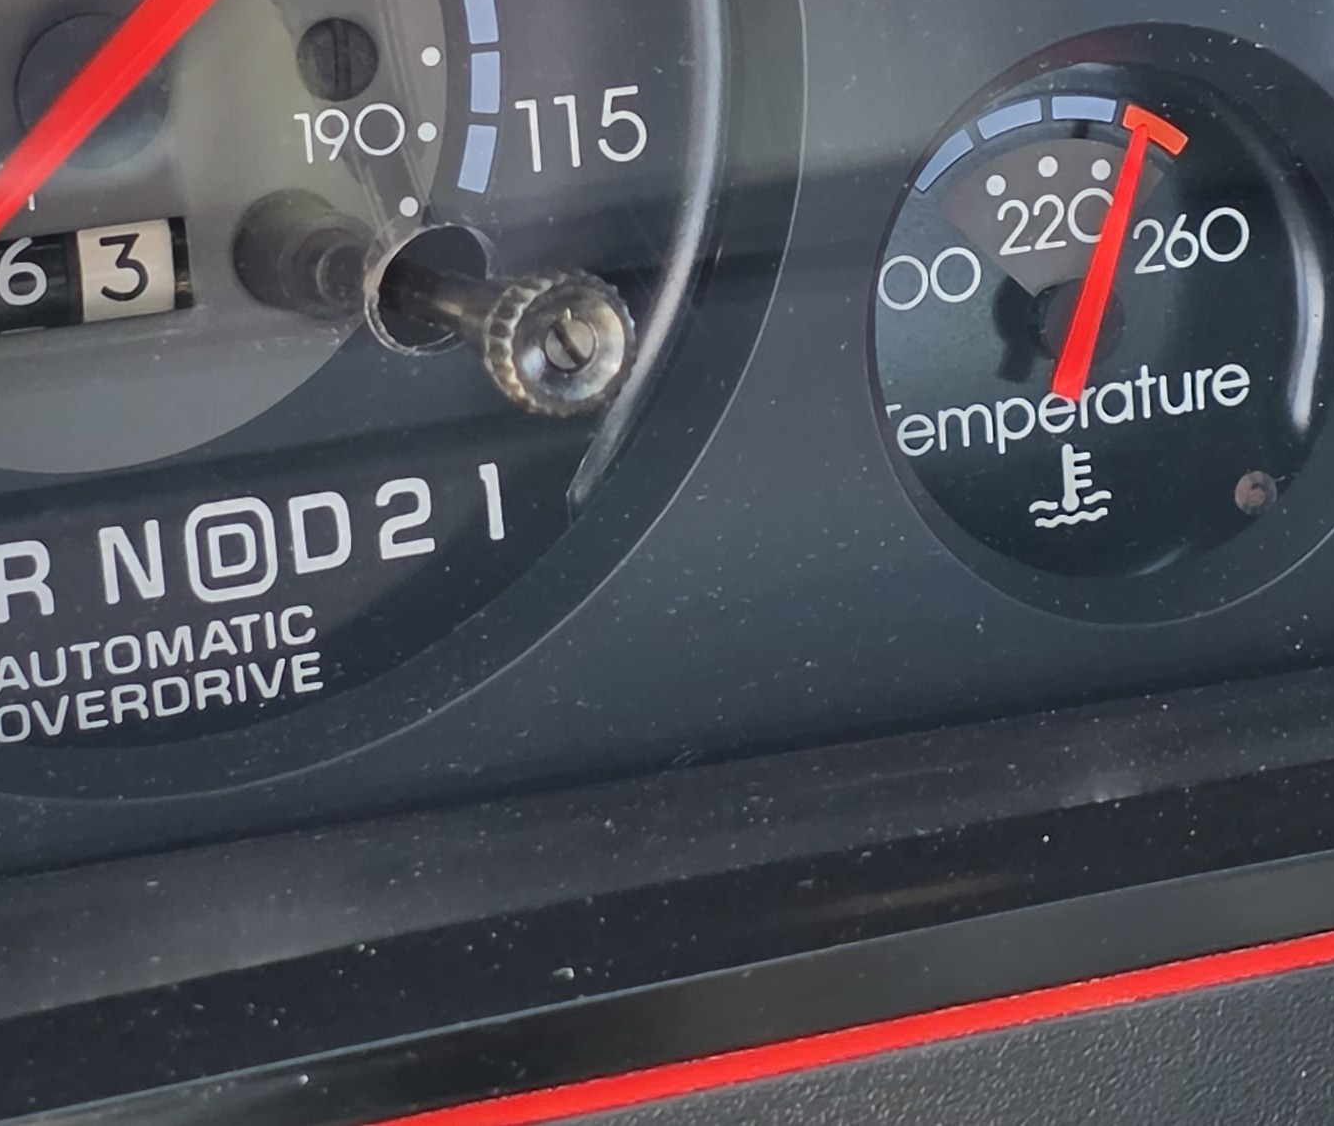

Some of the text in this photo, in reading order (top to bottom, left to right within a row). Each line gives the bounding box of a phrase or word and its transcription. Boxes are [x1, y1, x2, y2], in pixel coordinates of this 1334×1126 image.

[293, 102, 406, 164] 190
[514, 84, 648, 174] 115
[996, 187, 1115, 256] 220
[1132, 206, 1251, 275] 260
[877, 246, 982, 311] 00
[98, 518, 166, 606] N
[288, 490, 353, 576] D
[376, 476, 436, 561] 2
[478, 462, 506, 541] 1
